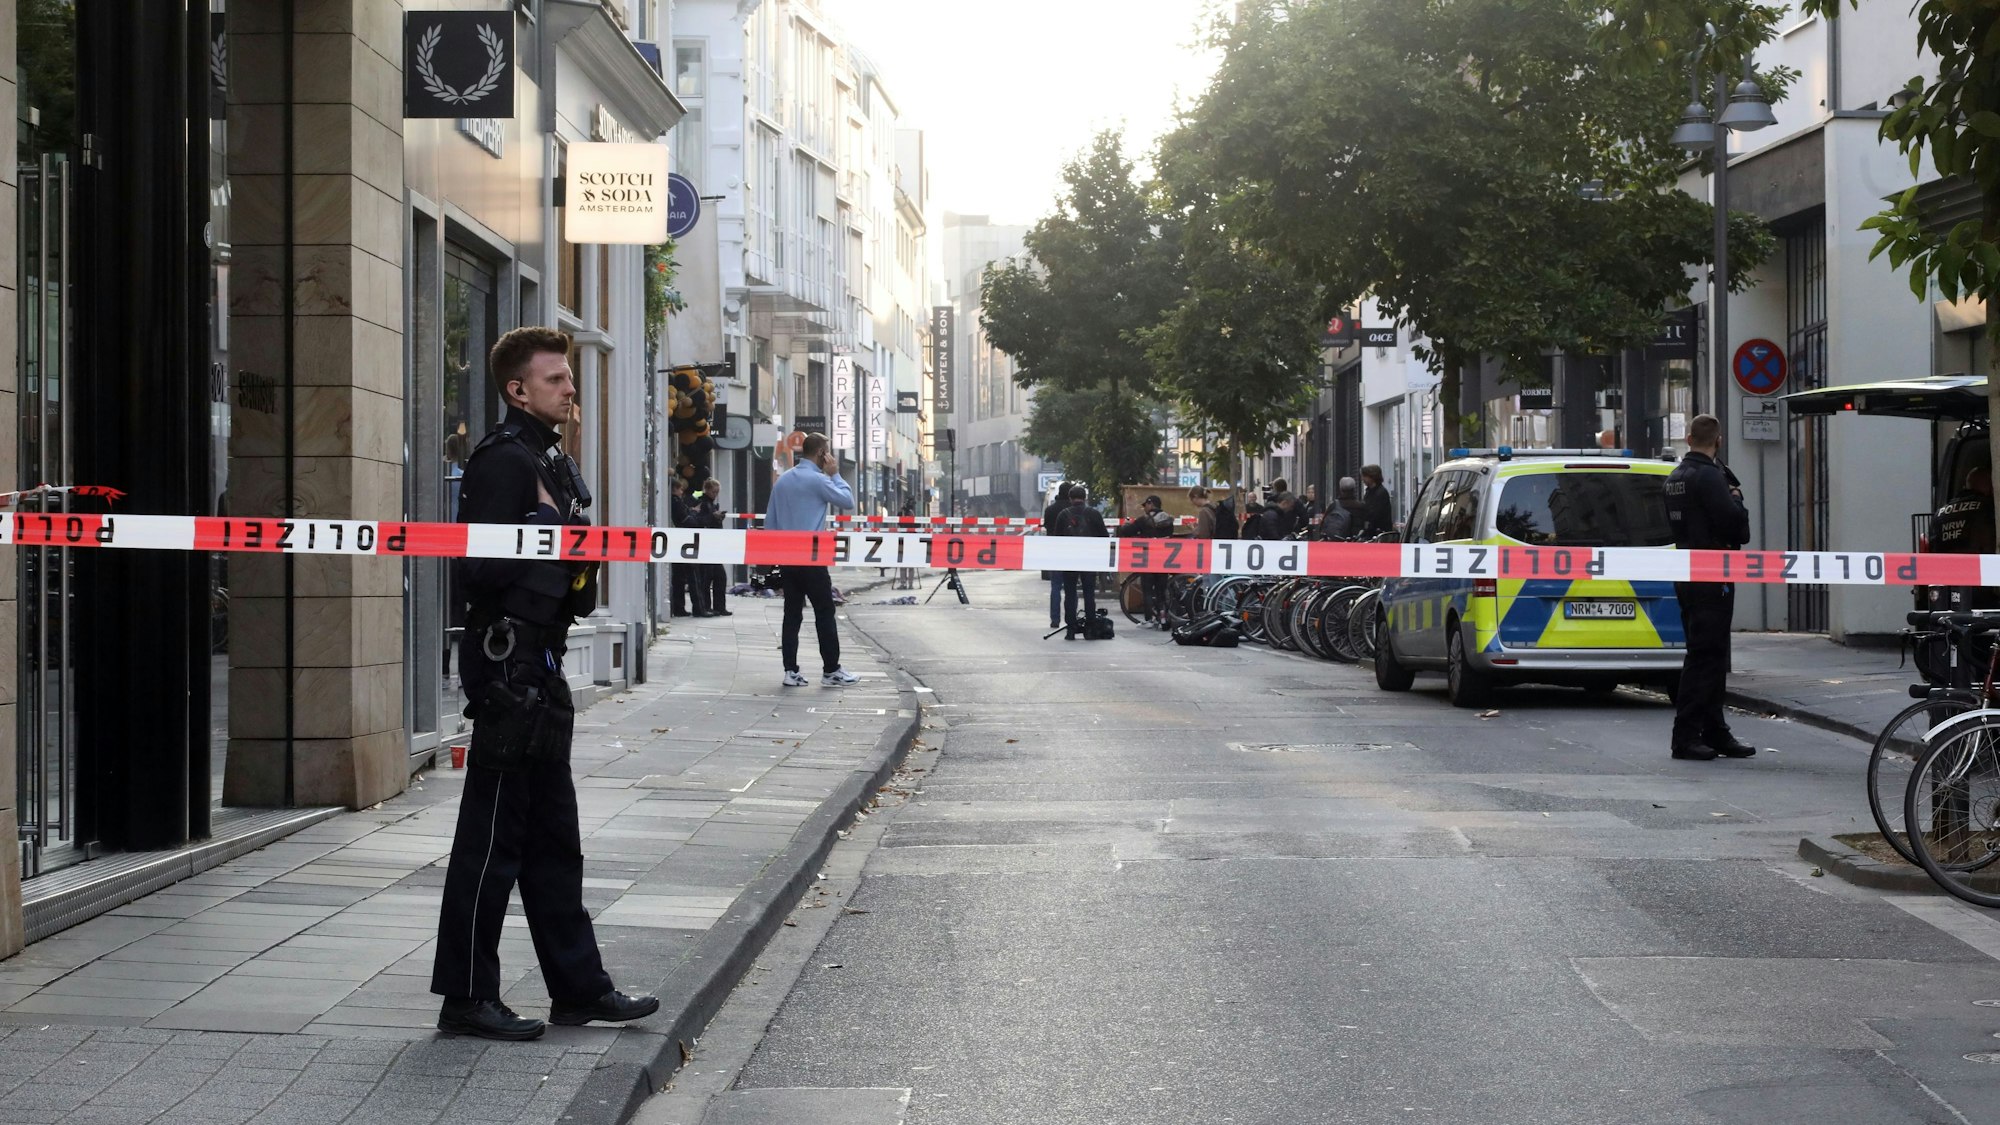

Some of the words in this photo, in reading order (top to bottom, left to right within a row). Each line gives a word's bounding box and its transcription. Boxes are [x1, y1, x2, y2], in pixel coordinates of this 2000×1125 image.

[579, 172, 653, 186] SCOTCH
[601, 189, 652, 202] SODA
[579, 205, 653, 213] AMSTERDAM
[940, 310, 948, 335] SON
[940, 352, 948, 399] KAPTEN
[836, 359, 849, 447] ARKET
[871, 379, 882, 459] ARKET
[1666, 482, 1686, 495] POLIZEI
[1938, 501, 1981, 517] POLIZEI
[0, 513, 114, 544] POLI
[224, 521, 406, 551] POLIZEI
[1942, 520, 1966, 532] NRW
[1942, 529, 1962, 541] DHF
[516, 528, 700, 559] POLIZEI
[813, 536, 996, 565] POLIZEI
[1110, 541, 1298, 571] POLIZEI
[1414, 547, 1605, 576] POLIZEI
[1723, 554, 1917, 580] POLIZEI
[1571, 603, 1591, 616] NRW
[1597, 603, 1634, 616] 4-7009
